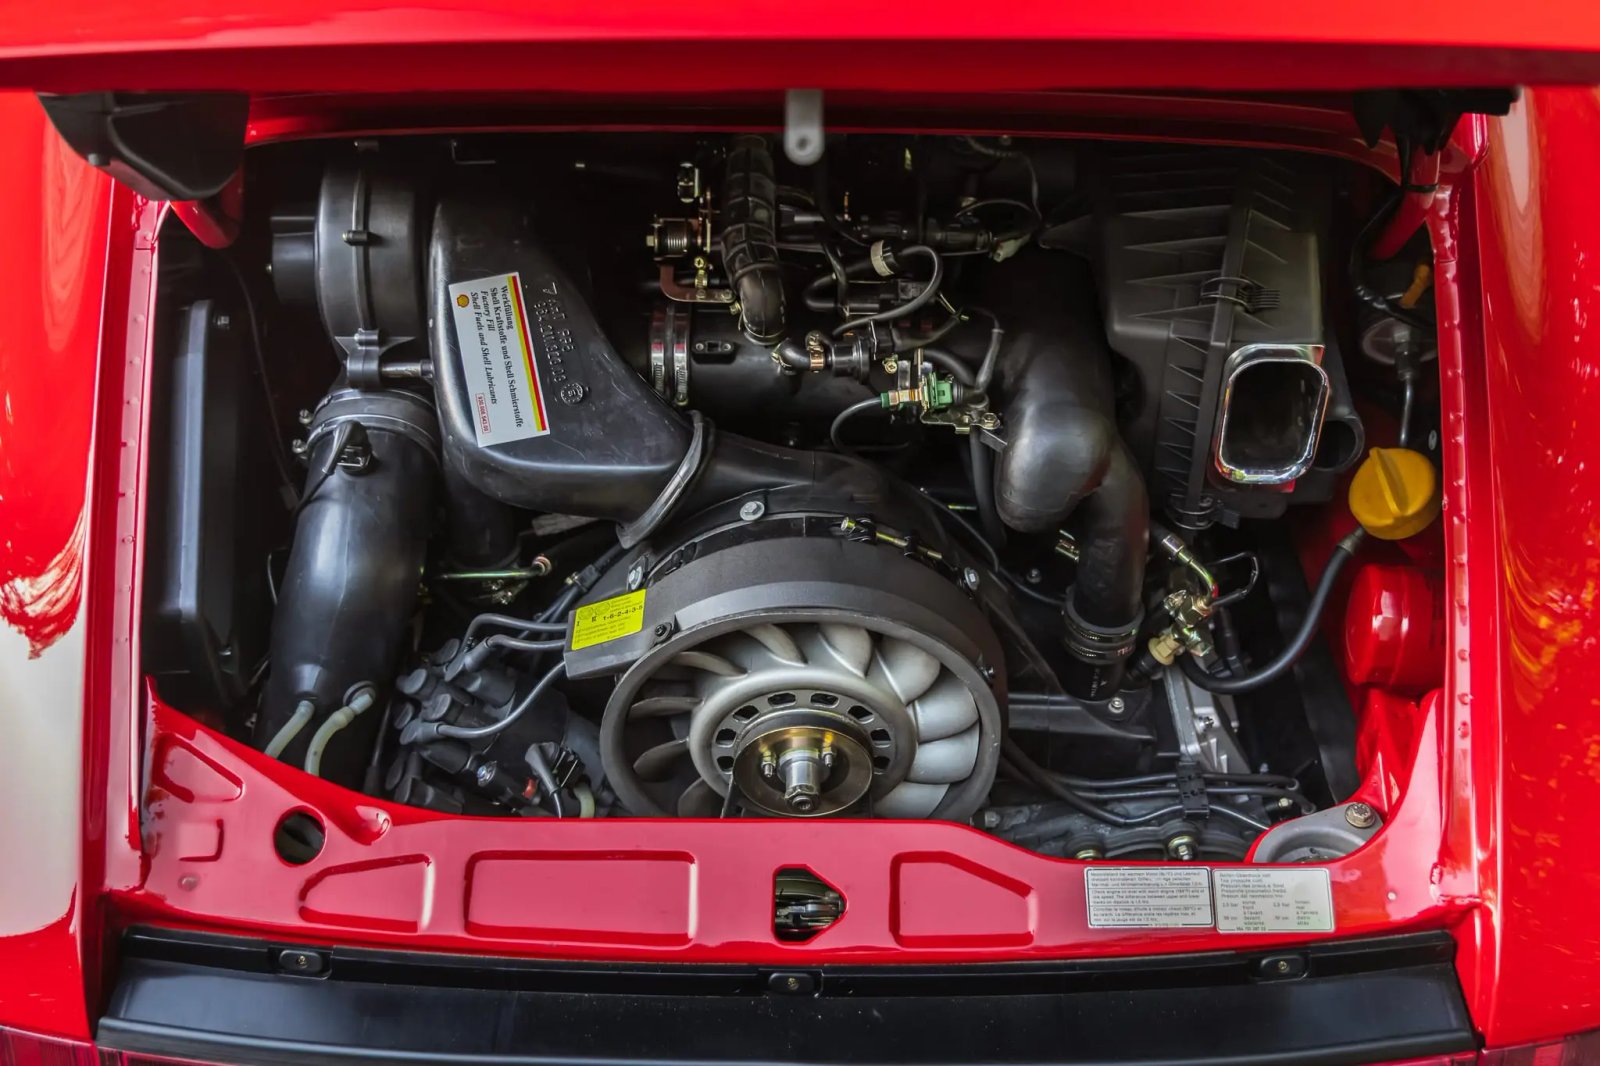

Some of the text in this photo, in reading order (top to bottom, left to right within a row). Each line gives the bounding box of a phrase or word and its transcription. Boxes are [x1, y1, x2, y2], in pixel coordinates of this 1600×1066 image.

[481, 290, 495, 331] Factory Fill
[501, 285, 513, 330] Werkfüllung
[471, 292, 497, 405] Shell Fuels and Shell Lubricants
[490, 287, 523, 428] Shell Kraftstoffe und Shell Schmierstoffe
